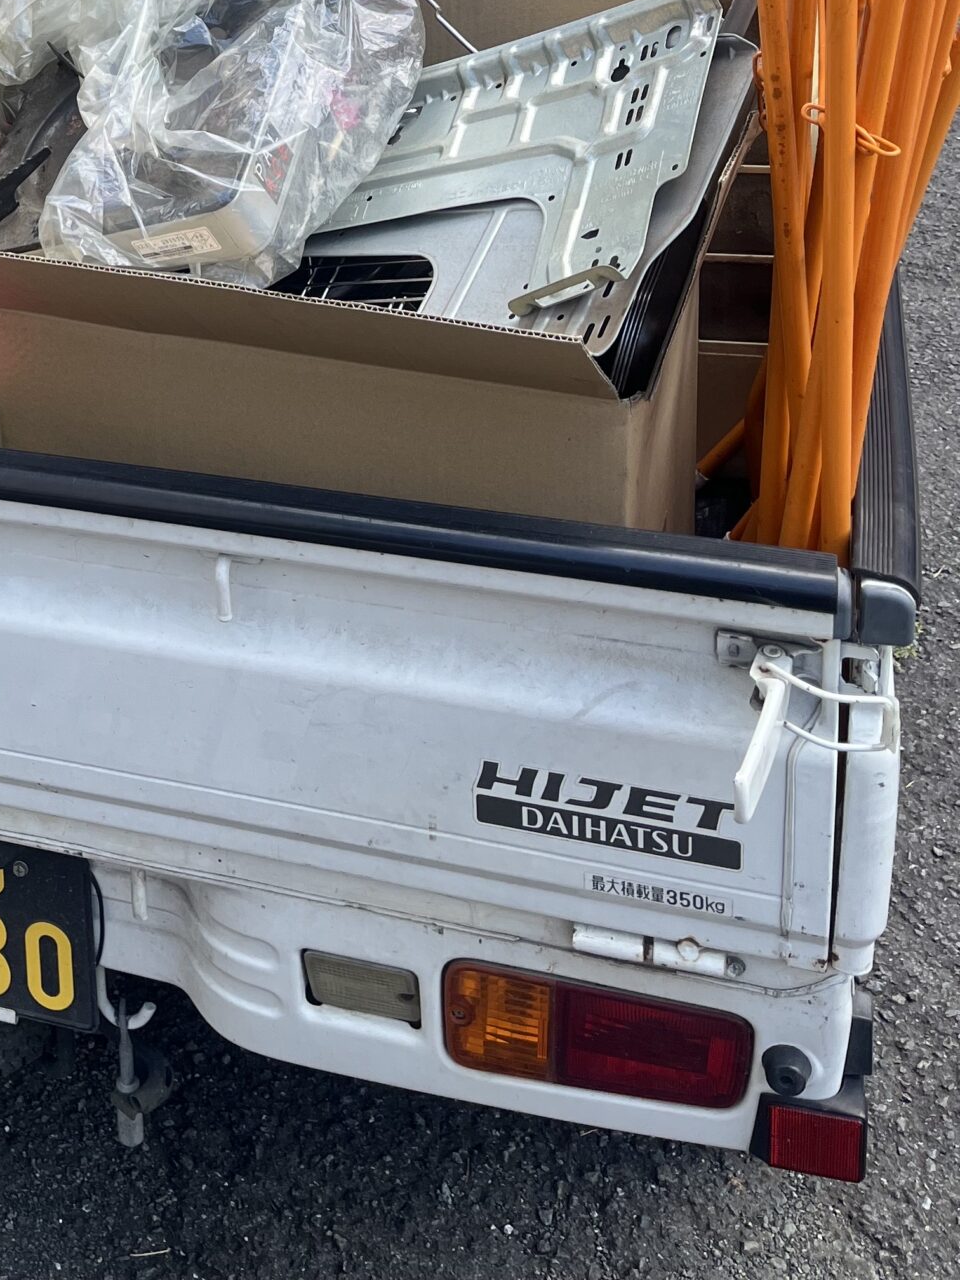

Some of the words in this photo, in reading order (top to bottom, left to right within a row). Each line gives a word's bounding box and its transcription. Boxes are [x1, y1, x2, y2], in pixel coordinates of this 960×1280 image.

[477, 761, 735, 830] HIJET
[521, 806, 693, 858] DAIHATSU
[591, 874, 726, 915] 最大積載量350kg
